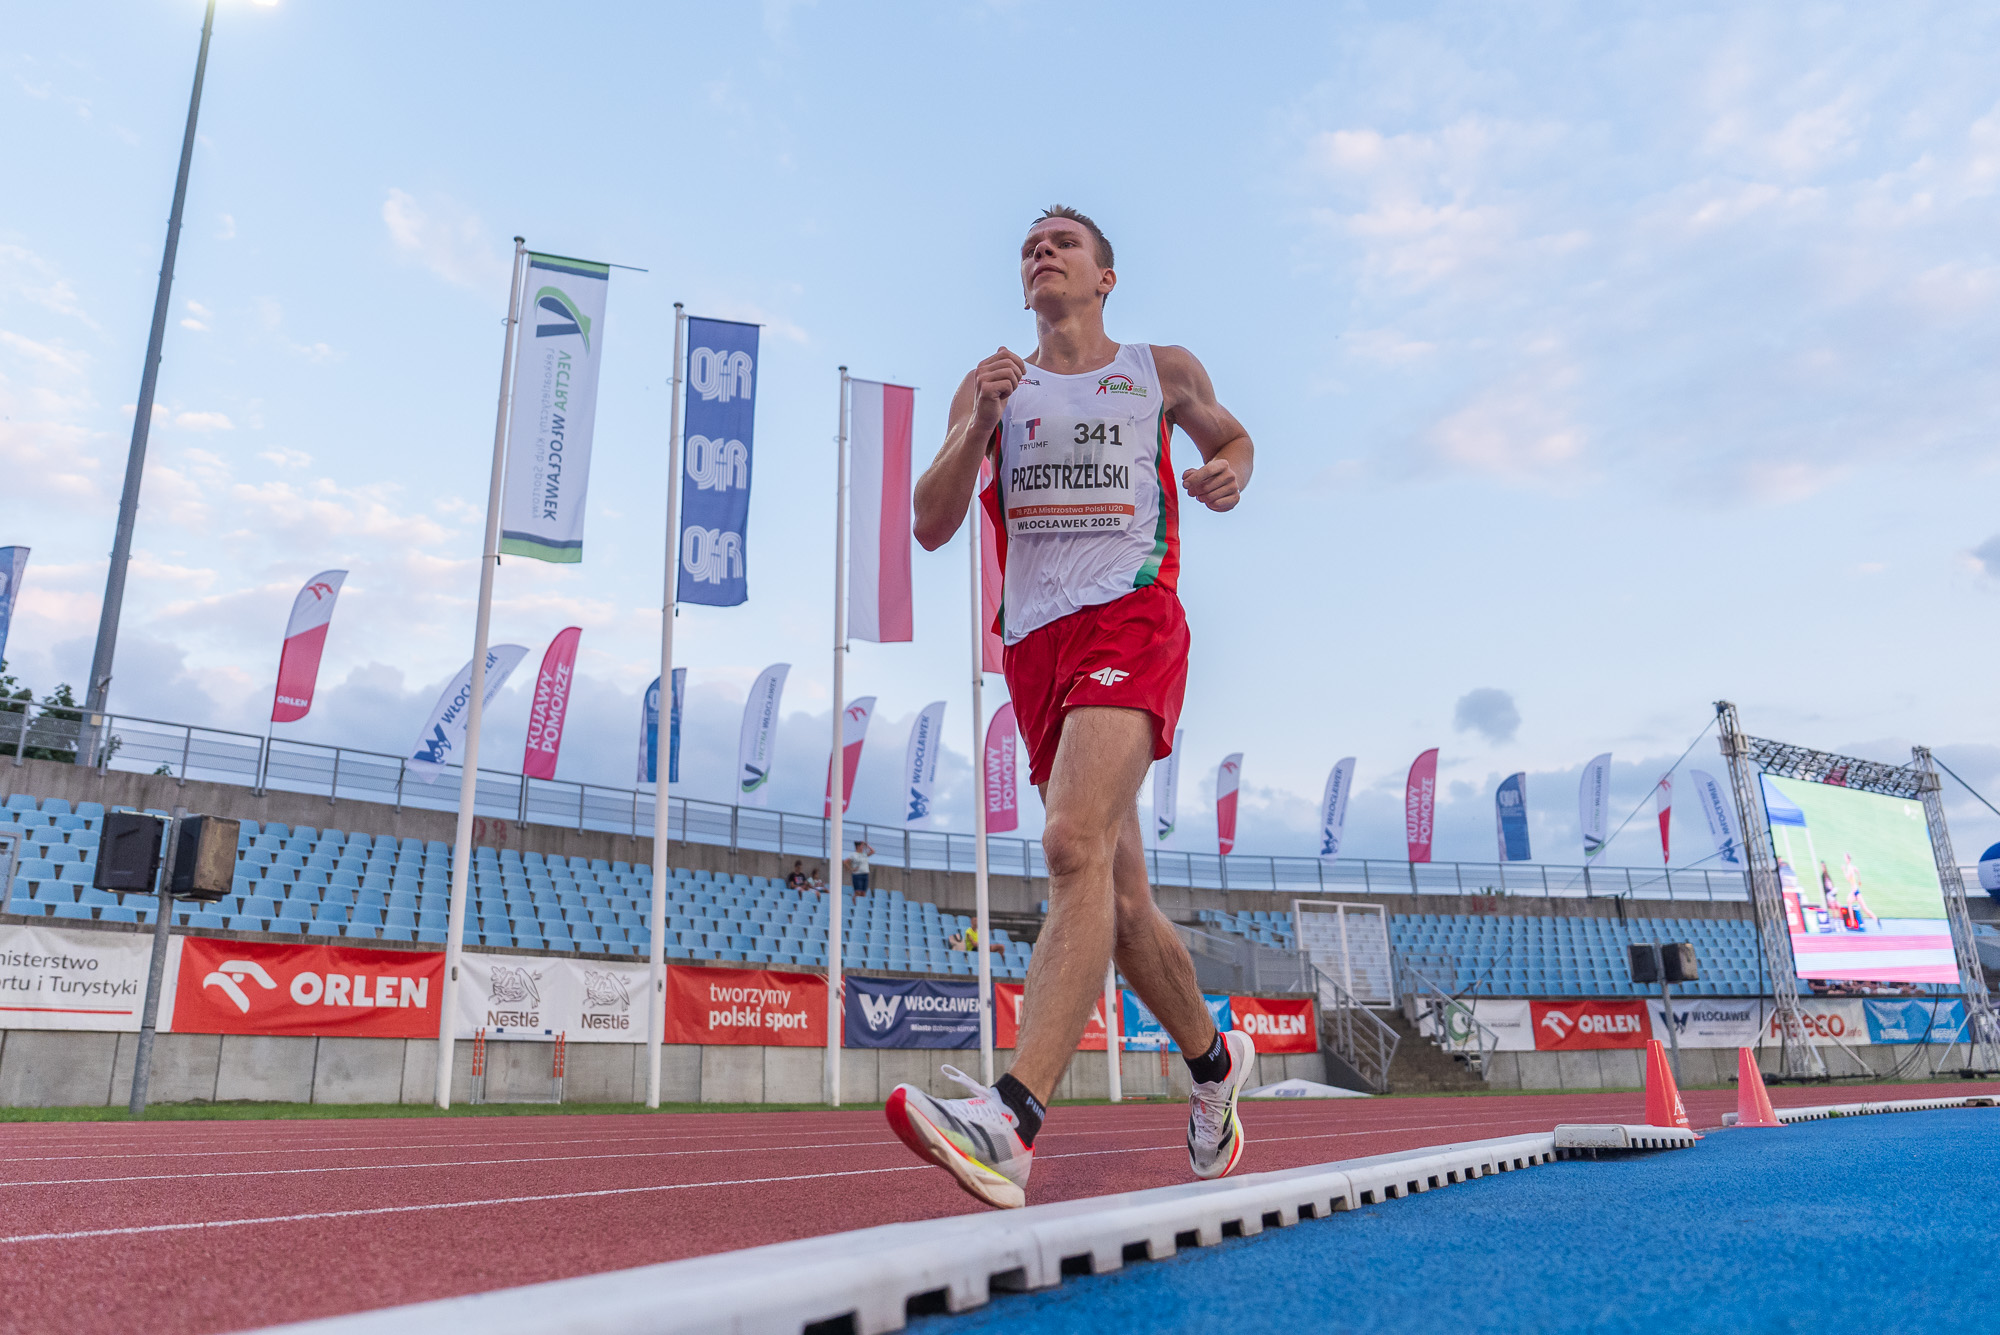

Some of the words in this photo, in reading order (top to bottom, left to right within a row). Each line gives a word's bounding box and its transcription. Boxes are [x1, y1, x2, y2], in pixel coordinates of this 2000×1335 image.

[1020, 441, 1049, 451] TRYUMF
[1073, 423, 1122, 446] 341
[1011, 464, 1129, 493] PRZESTRZELSKI
[1039, 506, 1083, 514] Mistrzostwa
[1017, 519, 1088, 531] WŁOCŁAWEK
[1091, 517, 1121, 527] 2025
[277, 695, 308, 708] ORLEN
[527, 671, 554, 751] KUJAWY
[542, 663, 571, 754] POMORZE
[989, 747, 1001, 812] KUJAWY
[1003, 735, 1015, 810] POMORZE
[1408, 785, 1420, 844] KUJAWY
[1419, 777, 1433, 845] POMORZE
[0, 975, 30, 991] rtu
[37, 975, 43, 991] i
[51, 975, 138, 998] Turystyki
[290, 971, 429, 1009] ORLEN
[709, 983, 791, 1009] tworzymy
[708, 1006, 761, 1030] polski
[765, 1010, 808, 1033] sport
[1243, 1013, 1306, 1035] ORLEN
[1578, 1014, 1641, 1034] ORLEN
[1691, 1010, 1751, 1021] WŁOCŁAWEK
